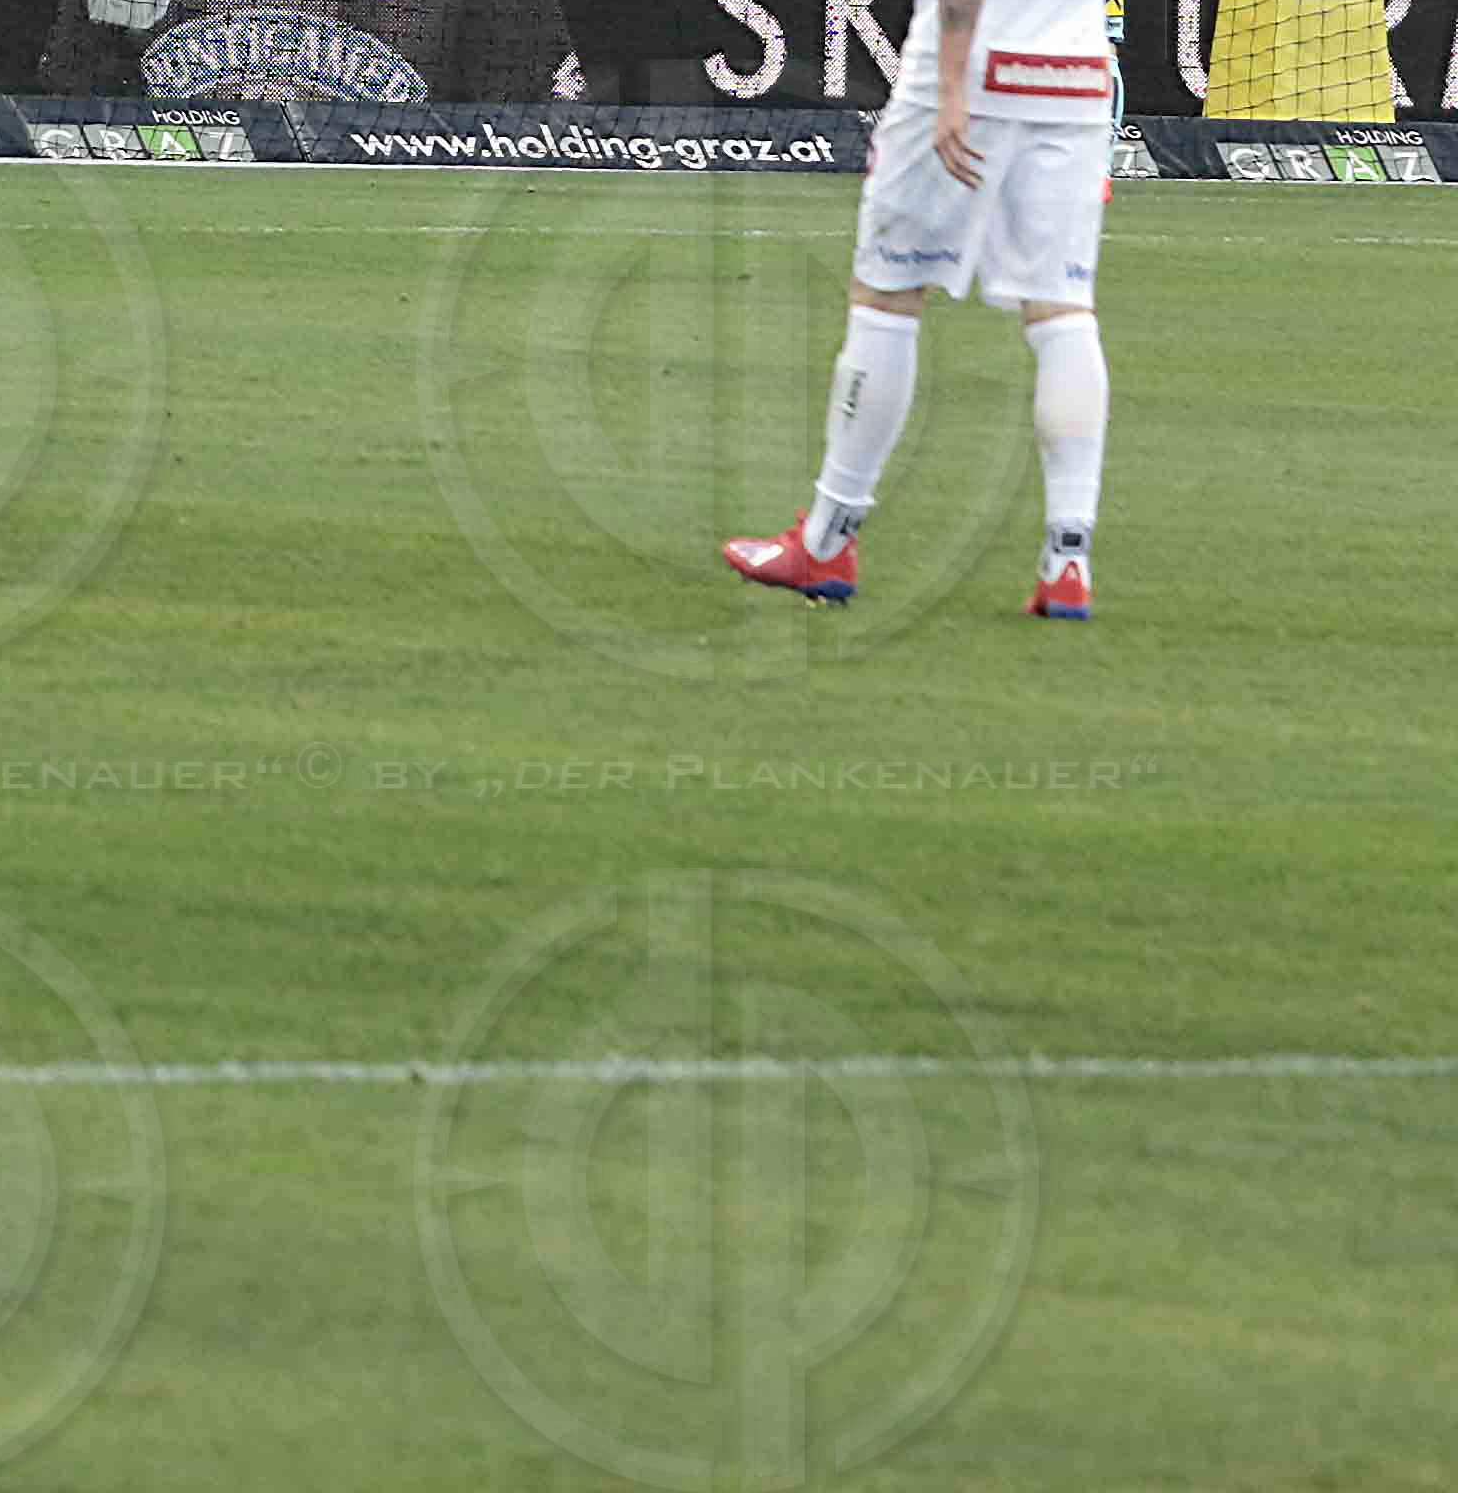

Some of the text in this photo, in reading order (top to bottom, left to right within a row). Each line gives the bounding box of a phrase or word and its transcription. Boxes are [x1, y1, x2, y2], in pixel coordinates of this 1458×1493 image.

[152, 108, 241, 128] HOLDING
[348, 125, 834, 171] www.holding-graz.at
[1335, 129, 1425, 148] HOLDING
